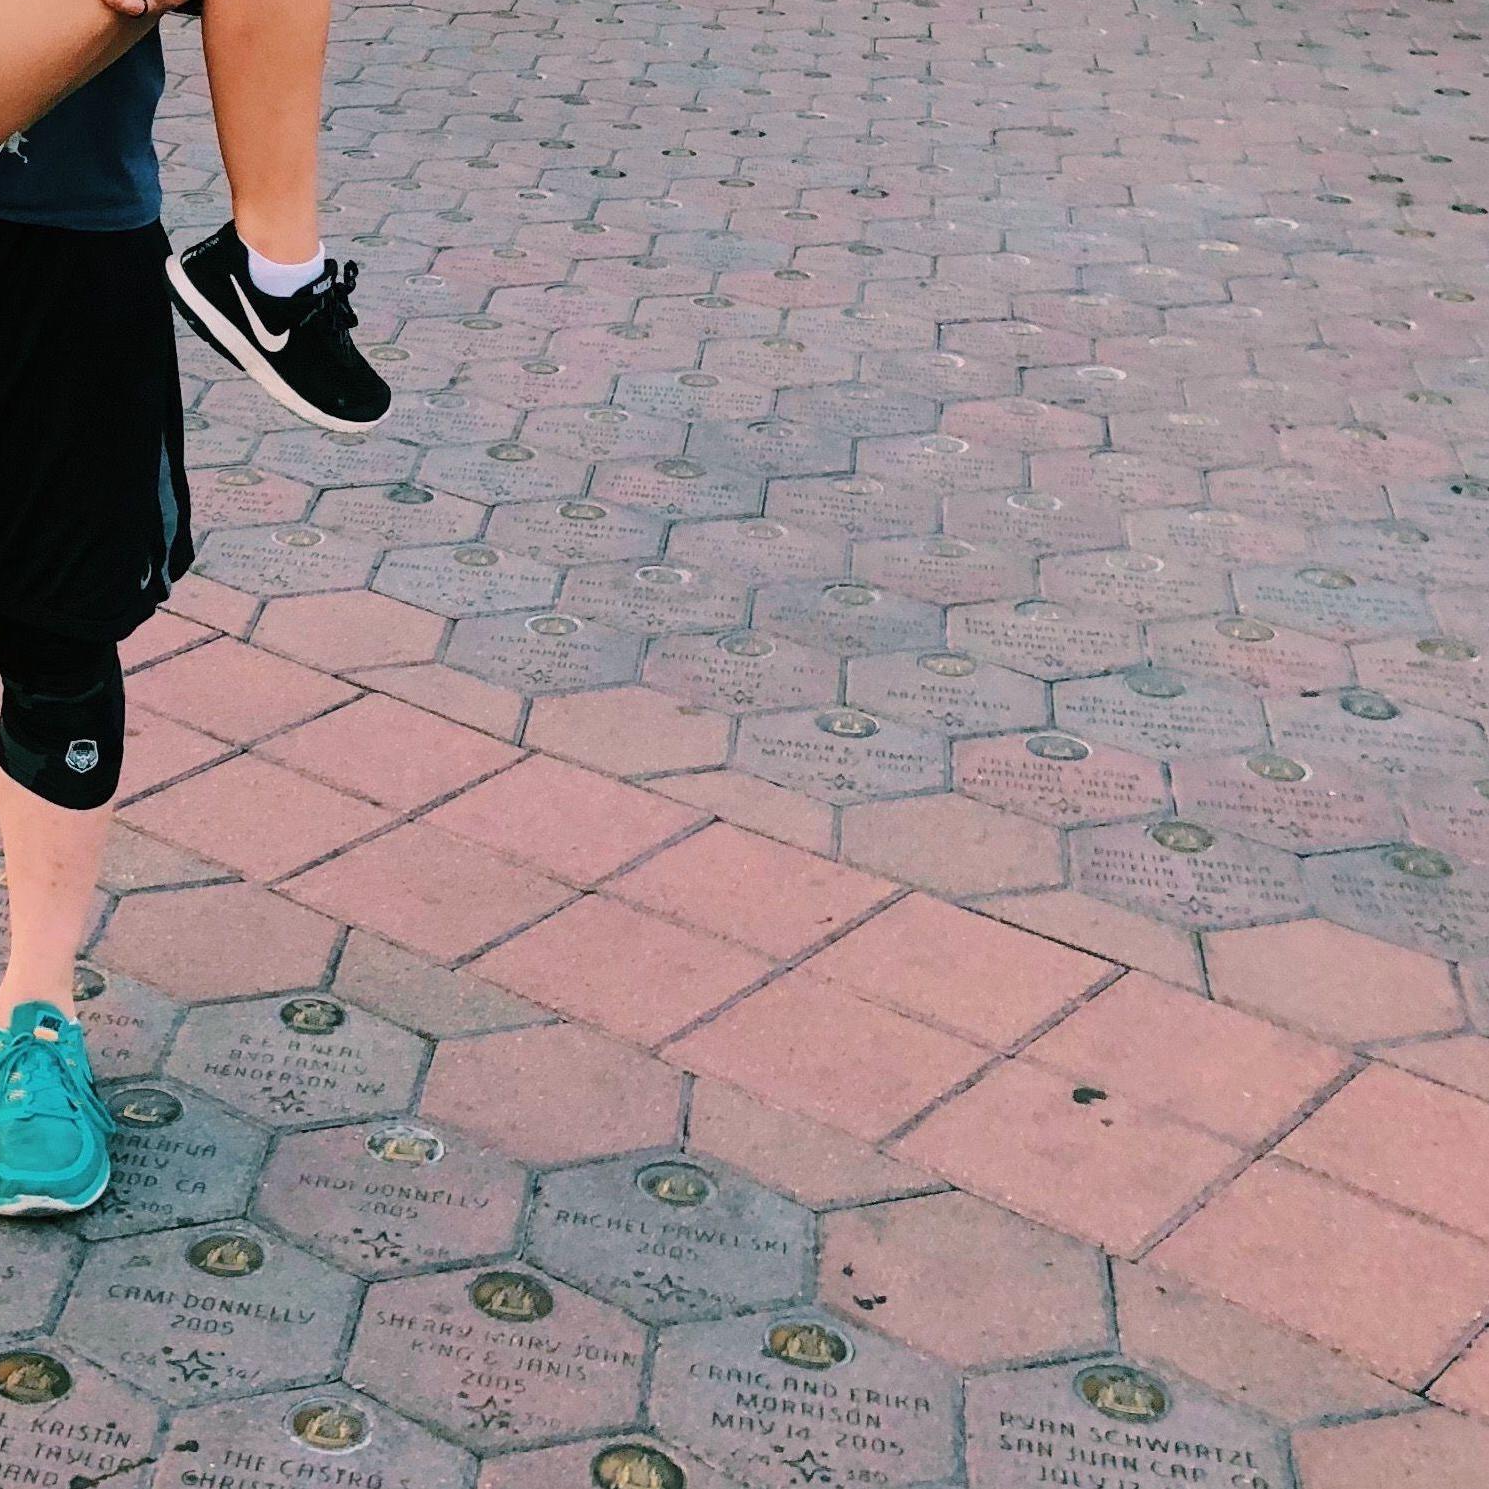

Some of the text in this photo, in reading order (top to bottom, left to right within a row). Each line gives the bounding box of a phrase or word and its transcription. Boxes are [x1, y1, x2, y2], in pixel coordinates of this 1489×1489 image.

[203, 1063, 338, 1093] HENDERSON
[110, 1151, 170, 1170] MILY
[176, 1178, 207, 1195] CA
[365, 1181, 489, 1209] DONNELLY
[555, 1210, 648, 1235] RACHEL
[183, 1294, 316, 1326] DONNELLY
[782, 1376, 837, 1399] AND
[735, 1392, 881, 1429] MORRISON
[30, 1416, 132, 1449] KRISTIN
[711, 1411, 774, 1436] MAY
[1000, 1411, 1075, 1438] RYAN
[999, 1434, 1052, 1458] SAN
[223, 1450, 266, 1472] THE
